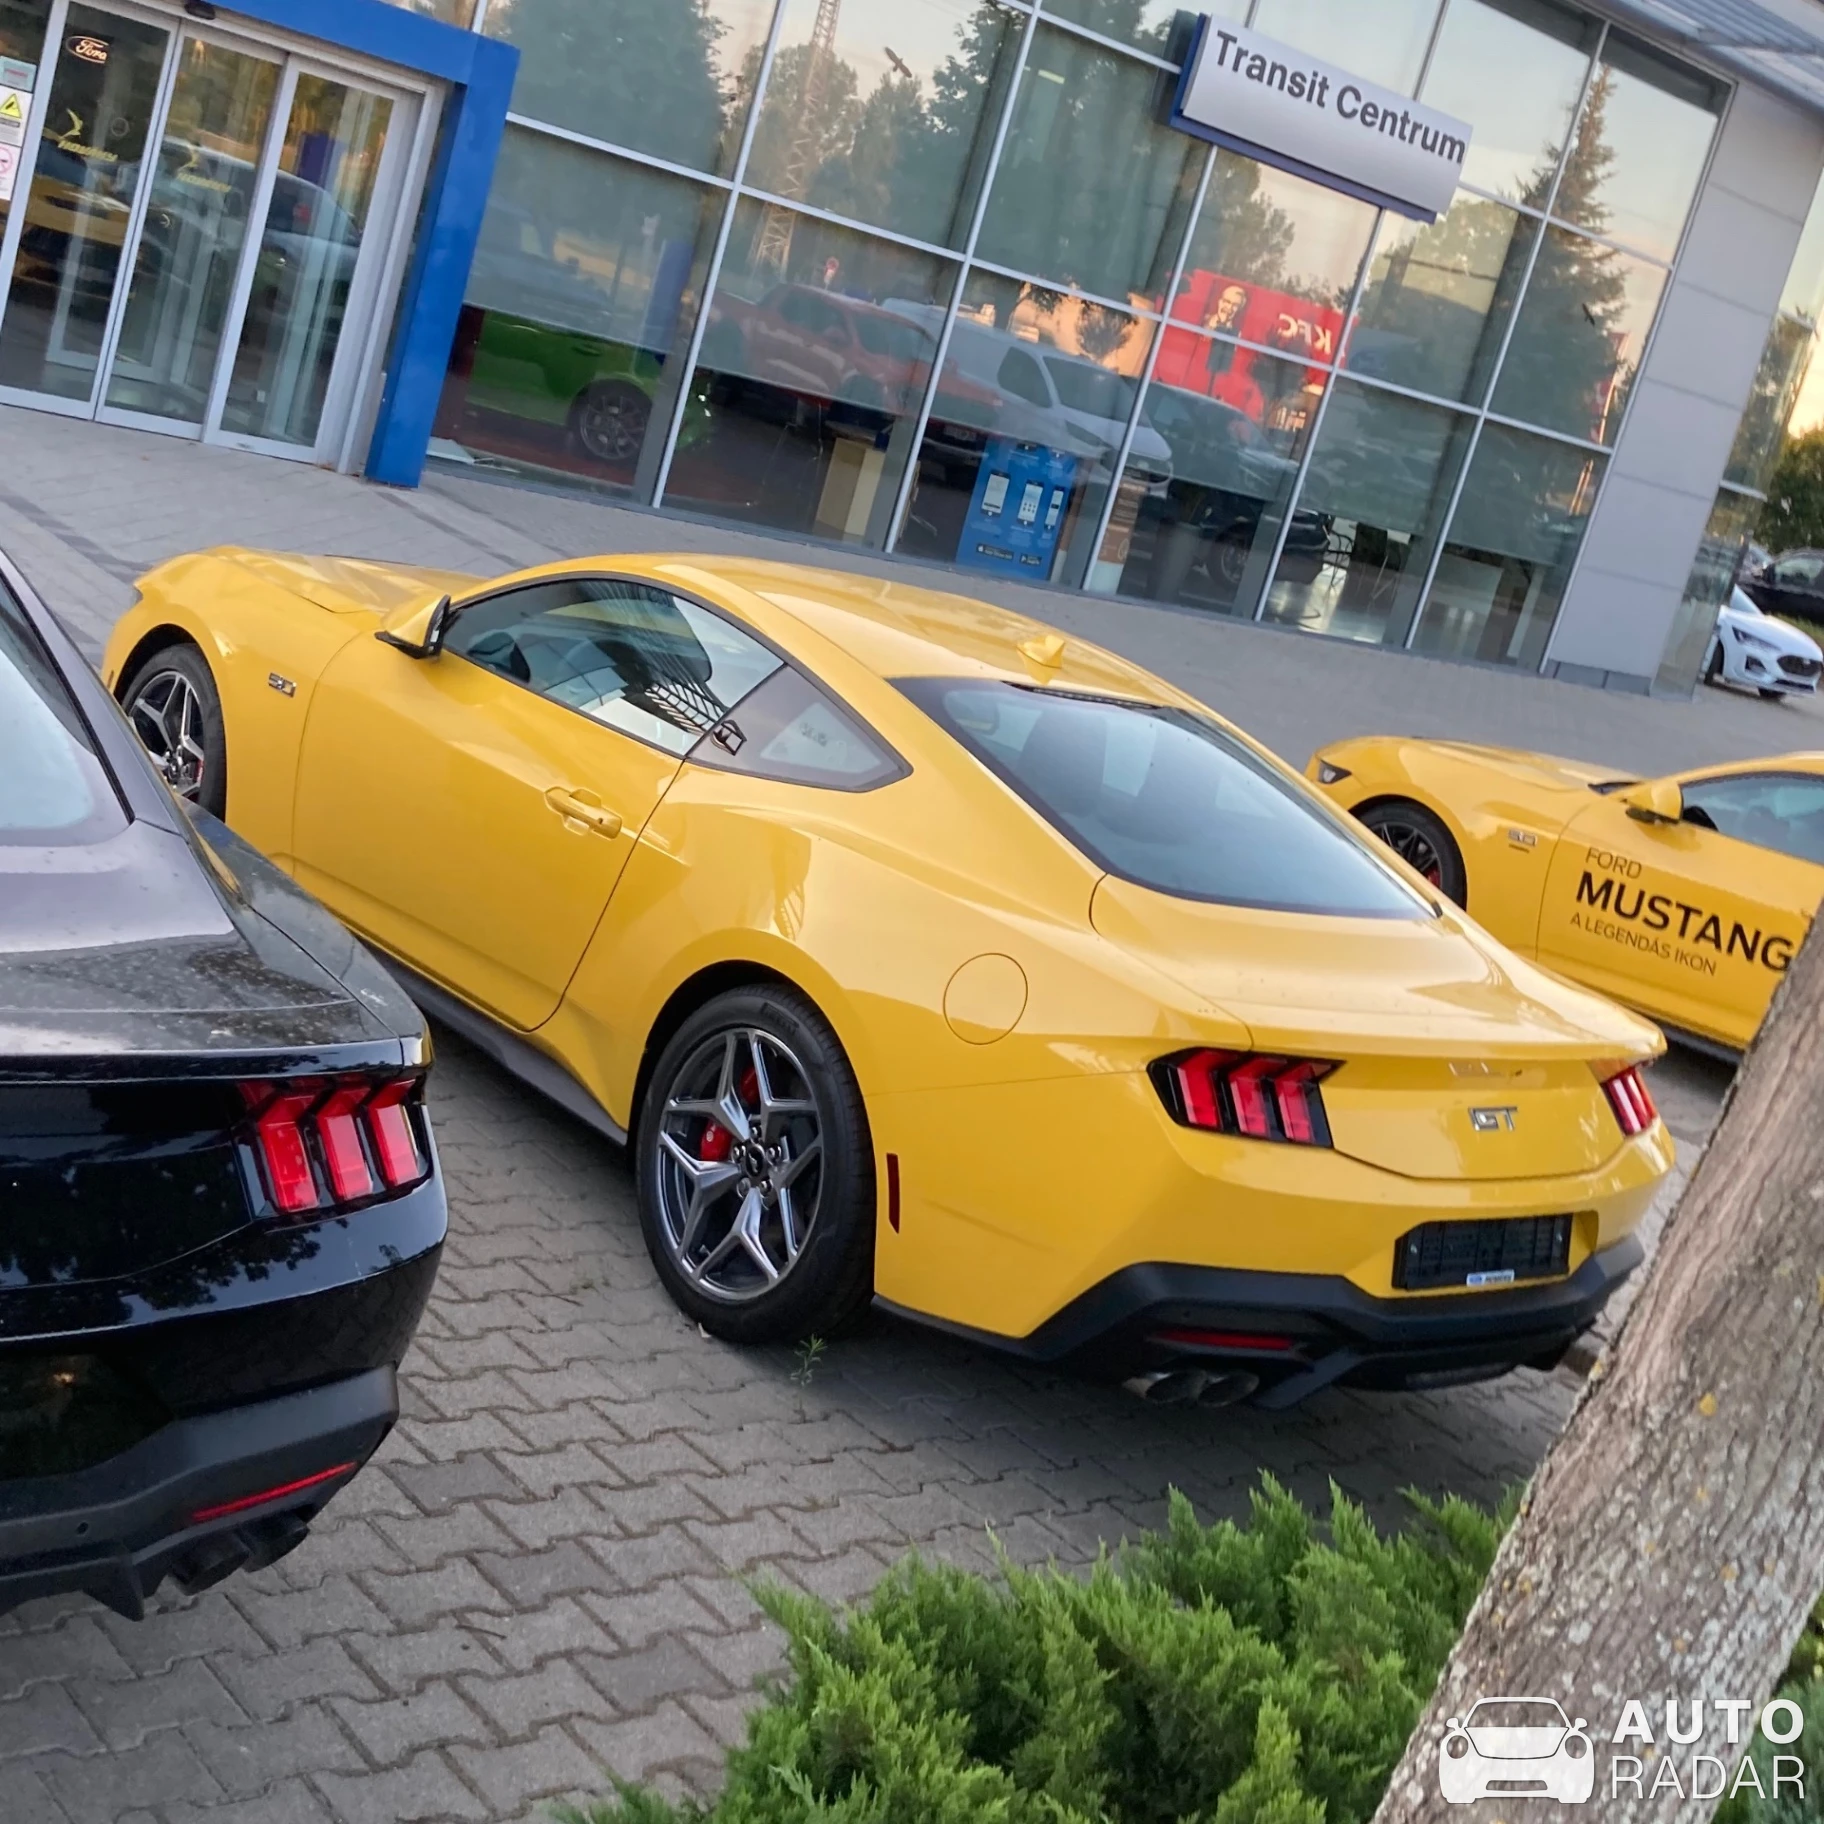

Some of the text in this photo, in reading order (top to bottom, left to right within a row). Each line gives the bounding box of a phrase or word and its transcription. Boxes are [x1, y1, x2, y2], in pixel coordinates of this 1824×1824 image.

[1217, 29, 1466, 164] Transit Centrum
[1585, 847, 1642, 880] FORD
[1570, 912, 1717, 977] A LEGENDÁS IKON
[1575, 870, 1795, 973] MUSTANG
[1467, 1106, 1518, 1131] GT
